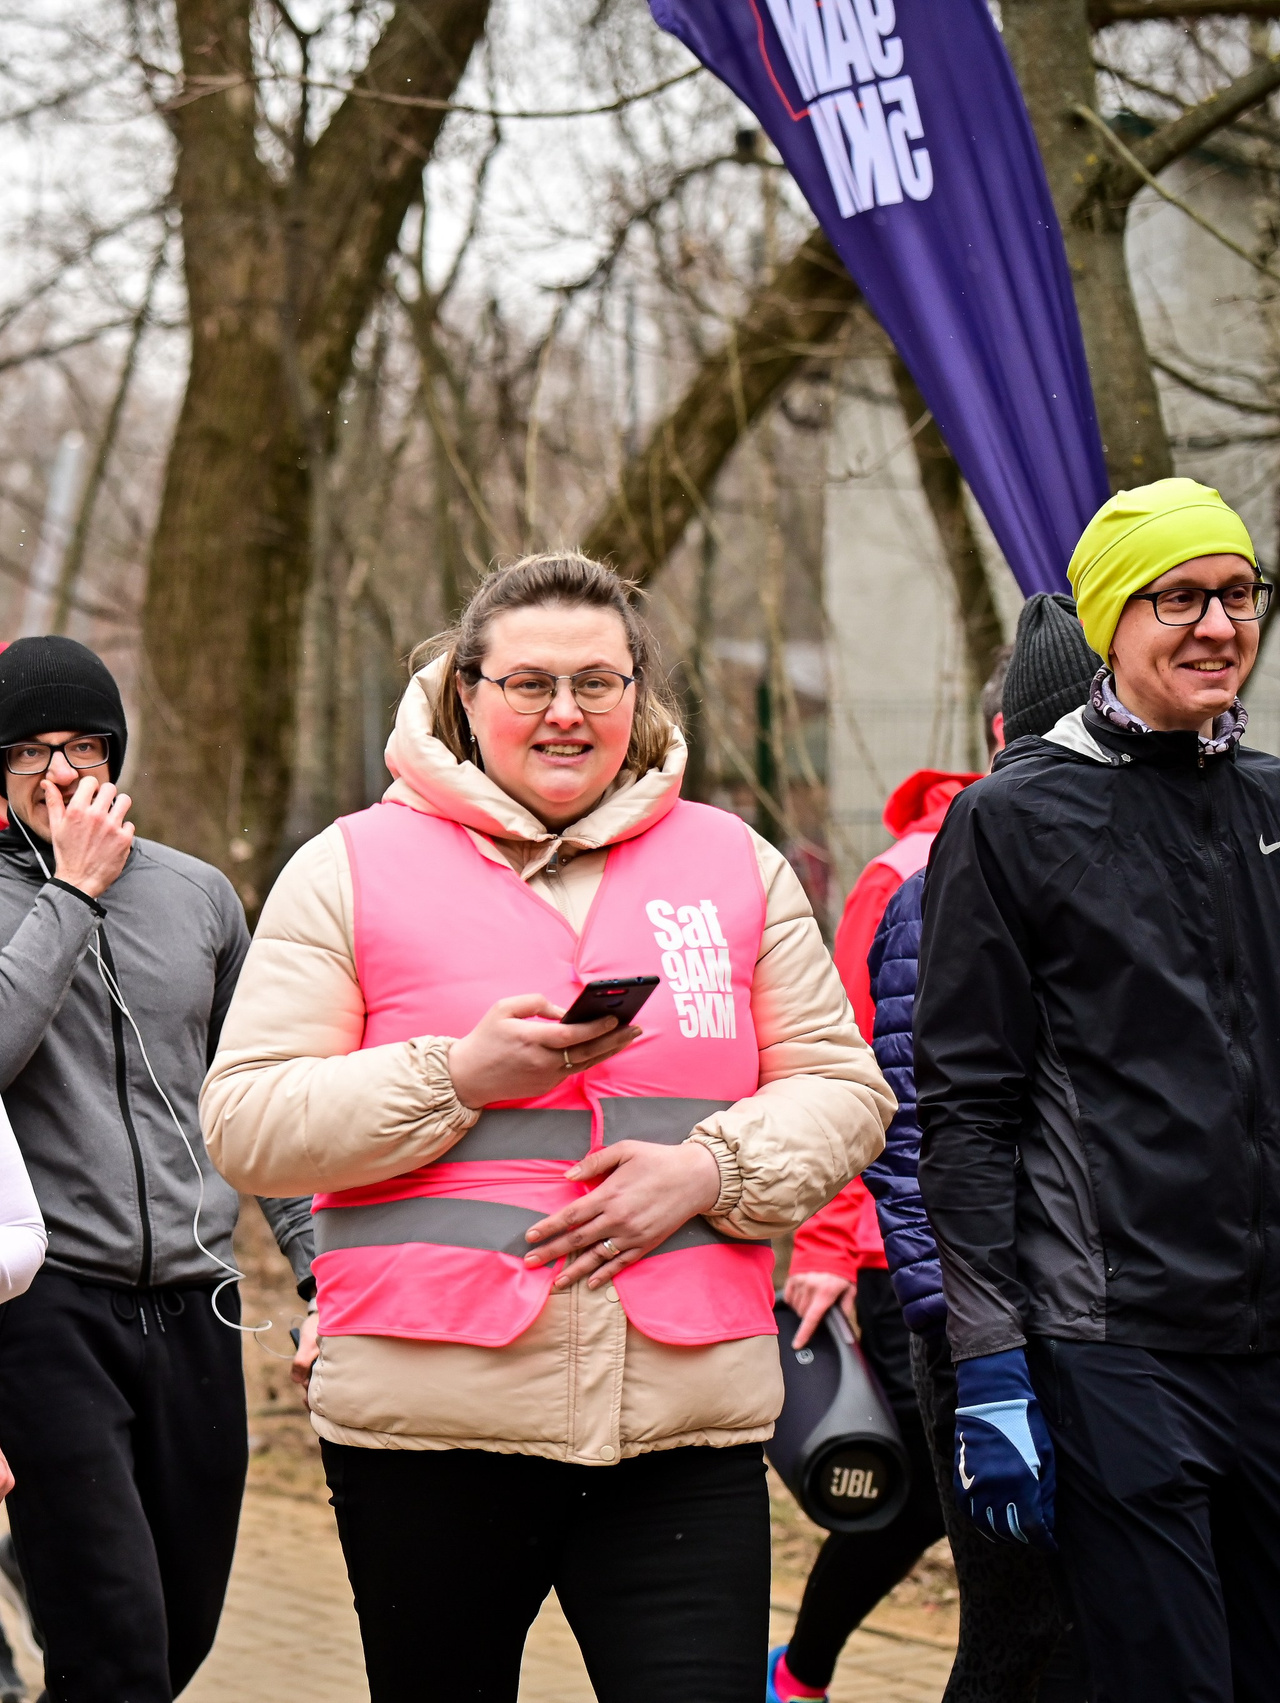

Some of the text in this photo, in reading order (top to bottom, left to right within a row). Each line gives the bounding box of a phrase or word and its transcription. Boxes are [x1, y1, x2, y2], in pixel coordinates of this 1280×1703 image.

[645, 899, 728, 951] Sat
[660, 948, 732, 993] 9AM
[673, 993, 737, 1039] 5KM
[830, 1467, 879, 1499] JBL
